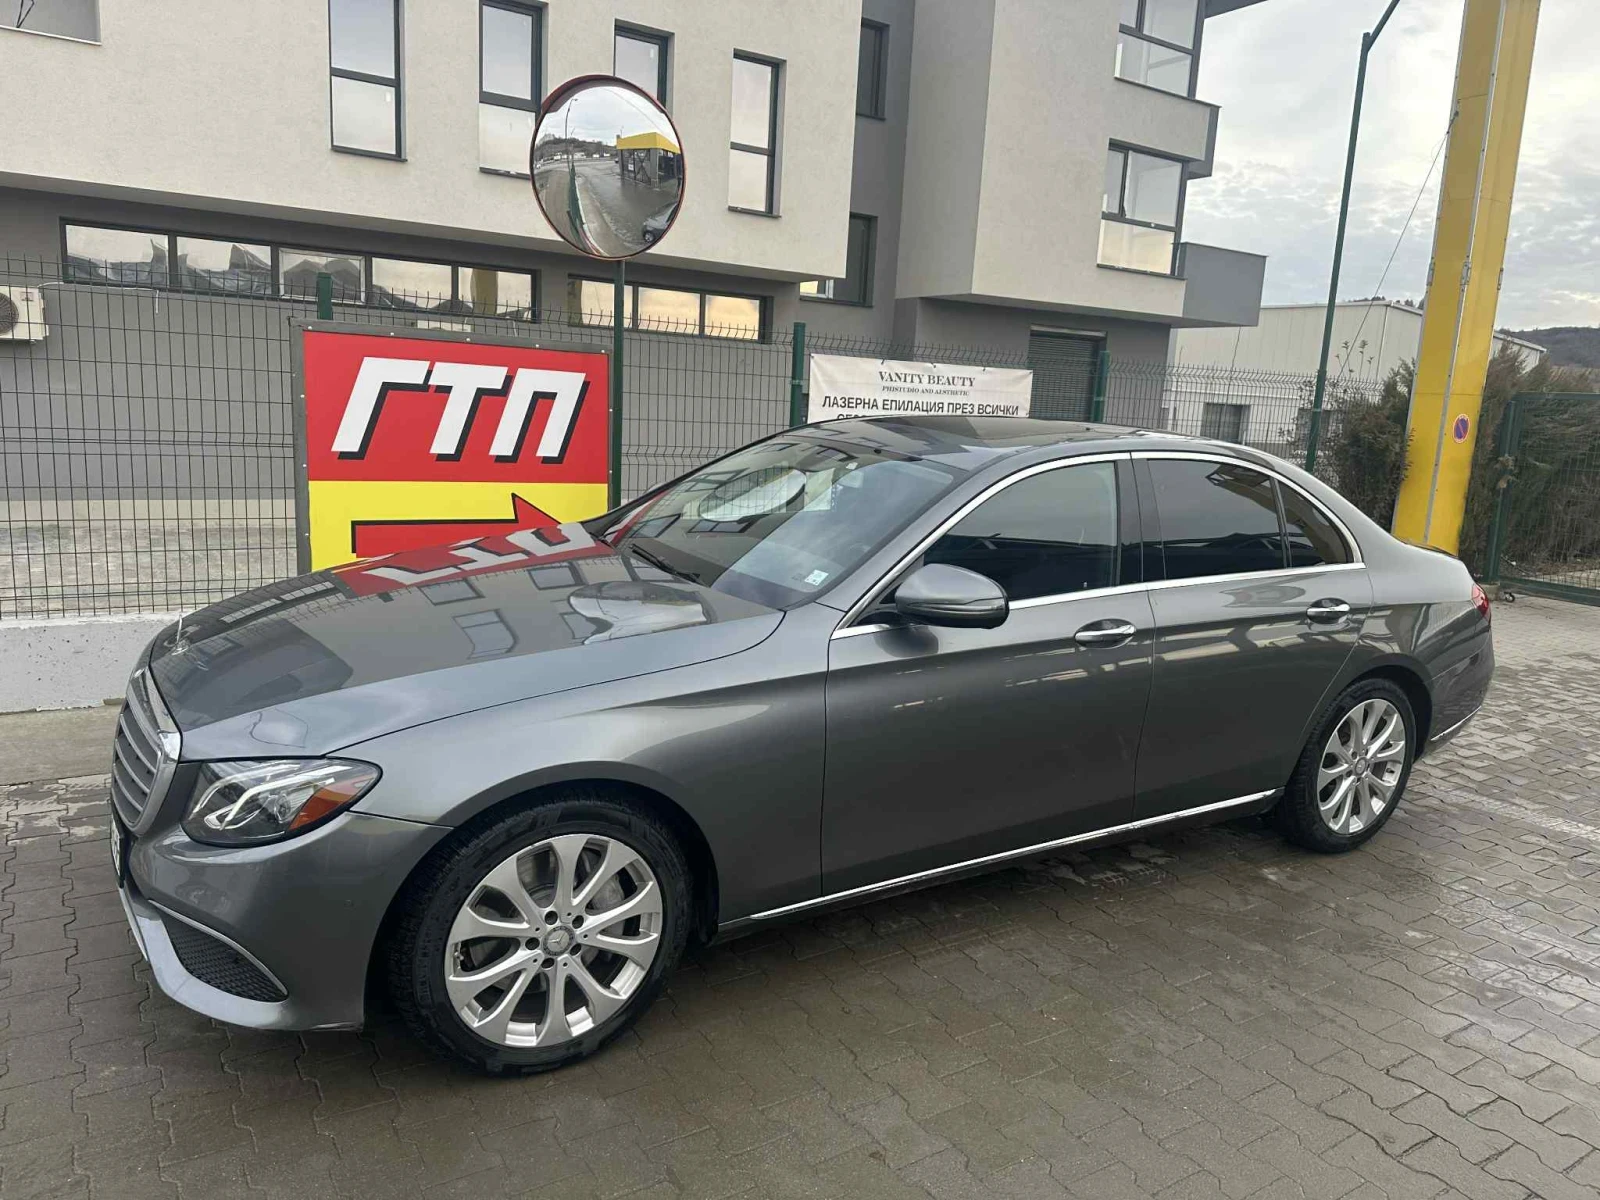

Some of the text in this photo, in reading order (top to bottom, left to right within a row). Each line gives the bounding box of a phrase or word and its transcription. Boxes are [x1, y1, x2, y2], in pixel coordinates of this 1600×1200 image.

[879, 371, 975, 387] VANITY BEAUTY
[331, 356, 590, 464] ГТП
[822, 395, 1019, 415] ЛАЗЕРНА ЕПИЛАЦИЯ ПРЕЗ ВСИЧКИ
